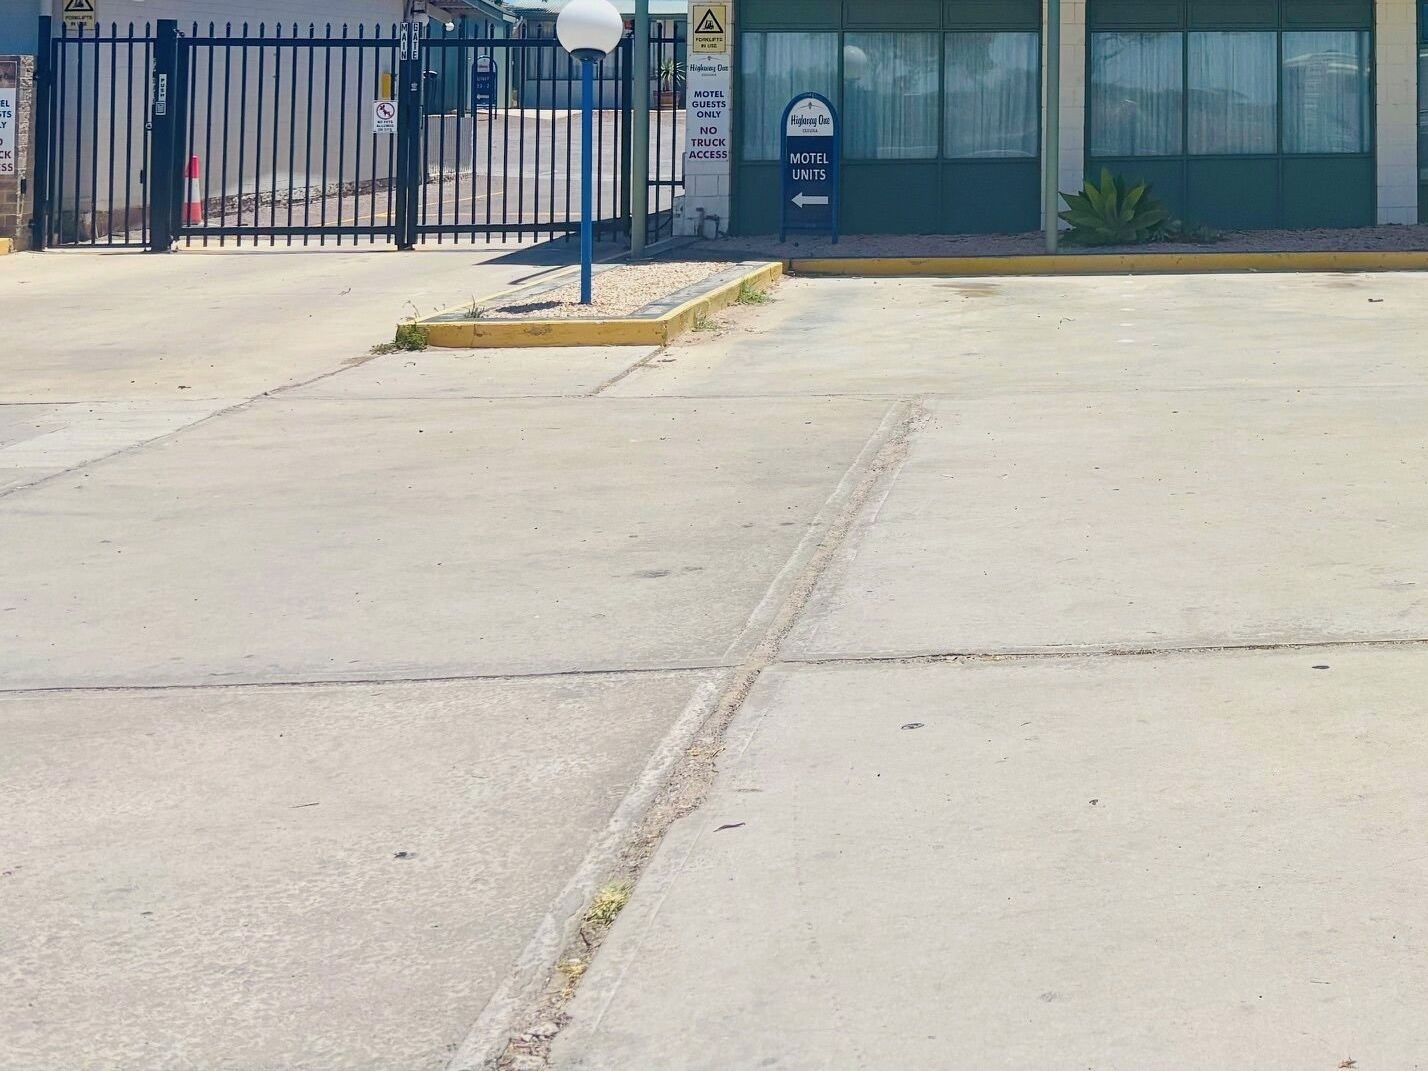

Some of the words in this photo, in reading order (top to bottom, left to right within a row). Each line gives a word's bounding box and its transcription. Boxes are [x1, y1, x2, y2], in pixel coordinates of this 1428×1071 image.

[694, 90, 725, 98] MOTEL
[691, 100, 727, 108] GUESTS
[696, 110, 722, 118] ONLY
[790, 114, 818, 128] Highway
[818, 114, 831, 126] One
[700, 126, 718, 135] NO
[691, 138, 726, 147] TRUCK
[688, 150, 728, 159] ACCESS
[790, 152, 829, 164] MOTEL
[792, 168, 826, 181] UNITS
